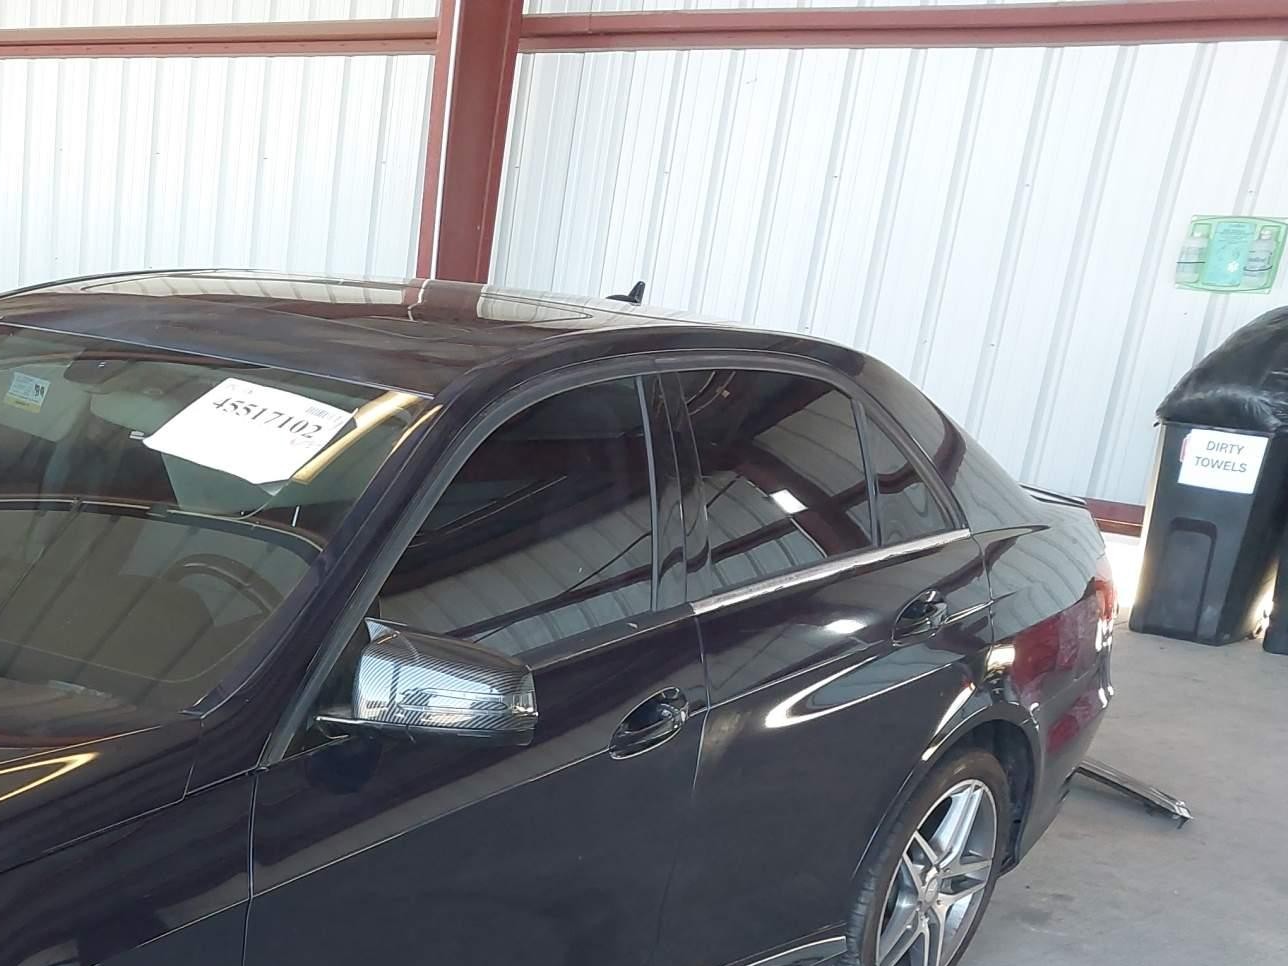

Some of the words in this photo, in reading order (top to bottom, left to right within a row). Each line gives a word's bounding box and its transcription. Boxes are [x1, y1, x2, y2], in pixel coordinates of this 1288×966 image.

[211, 396, 323, 440] 45517102
[1206, 440, 1245, 455] DIRTY
[1194, 456, 1247, 472] TOWELS
